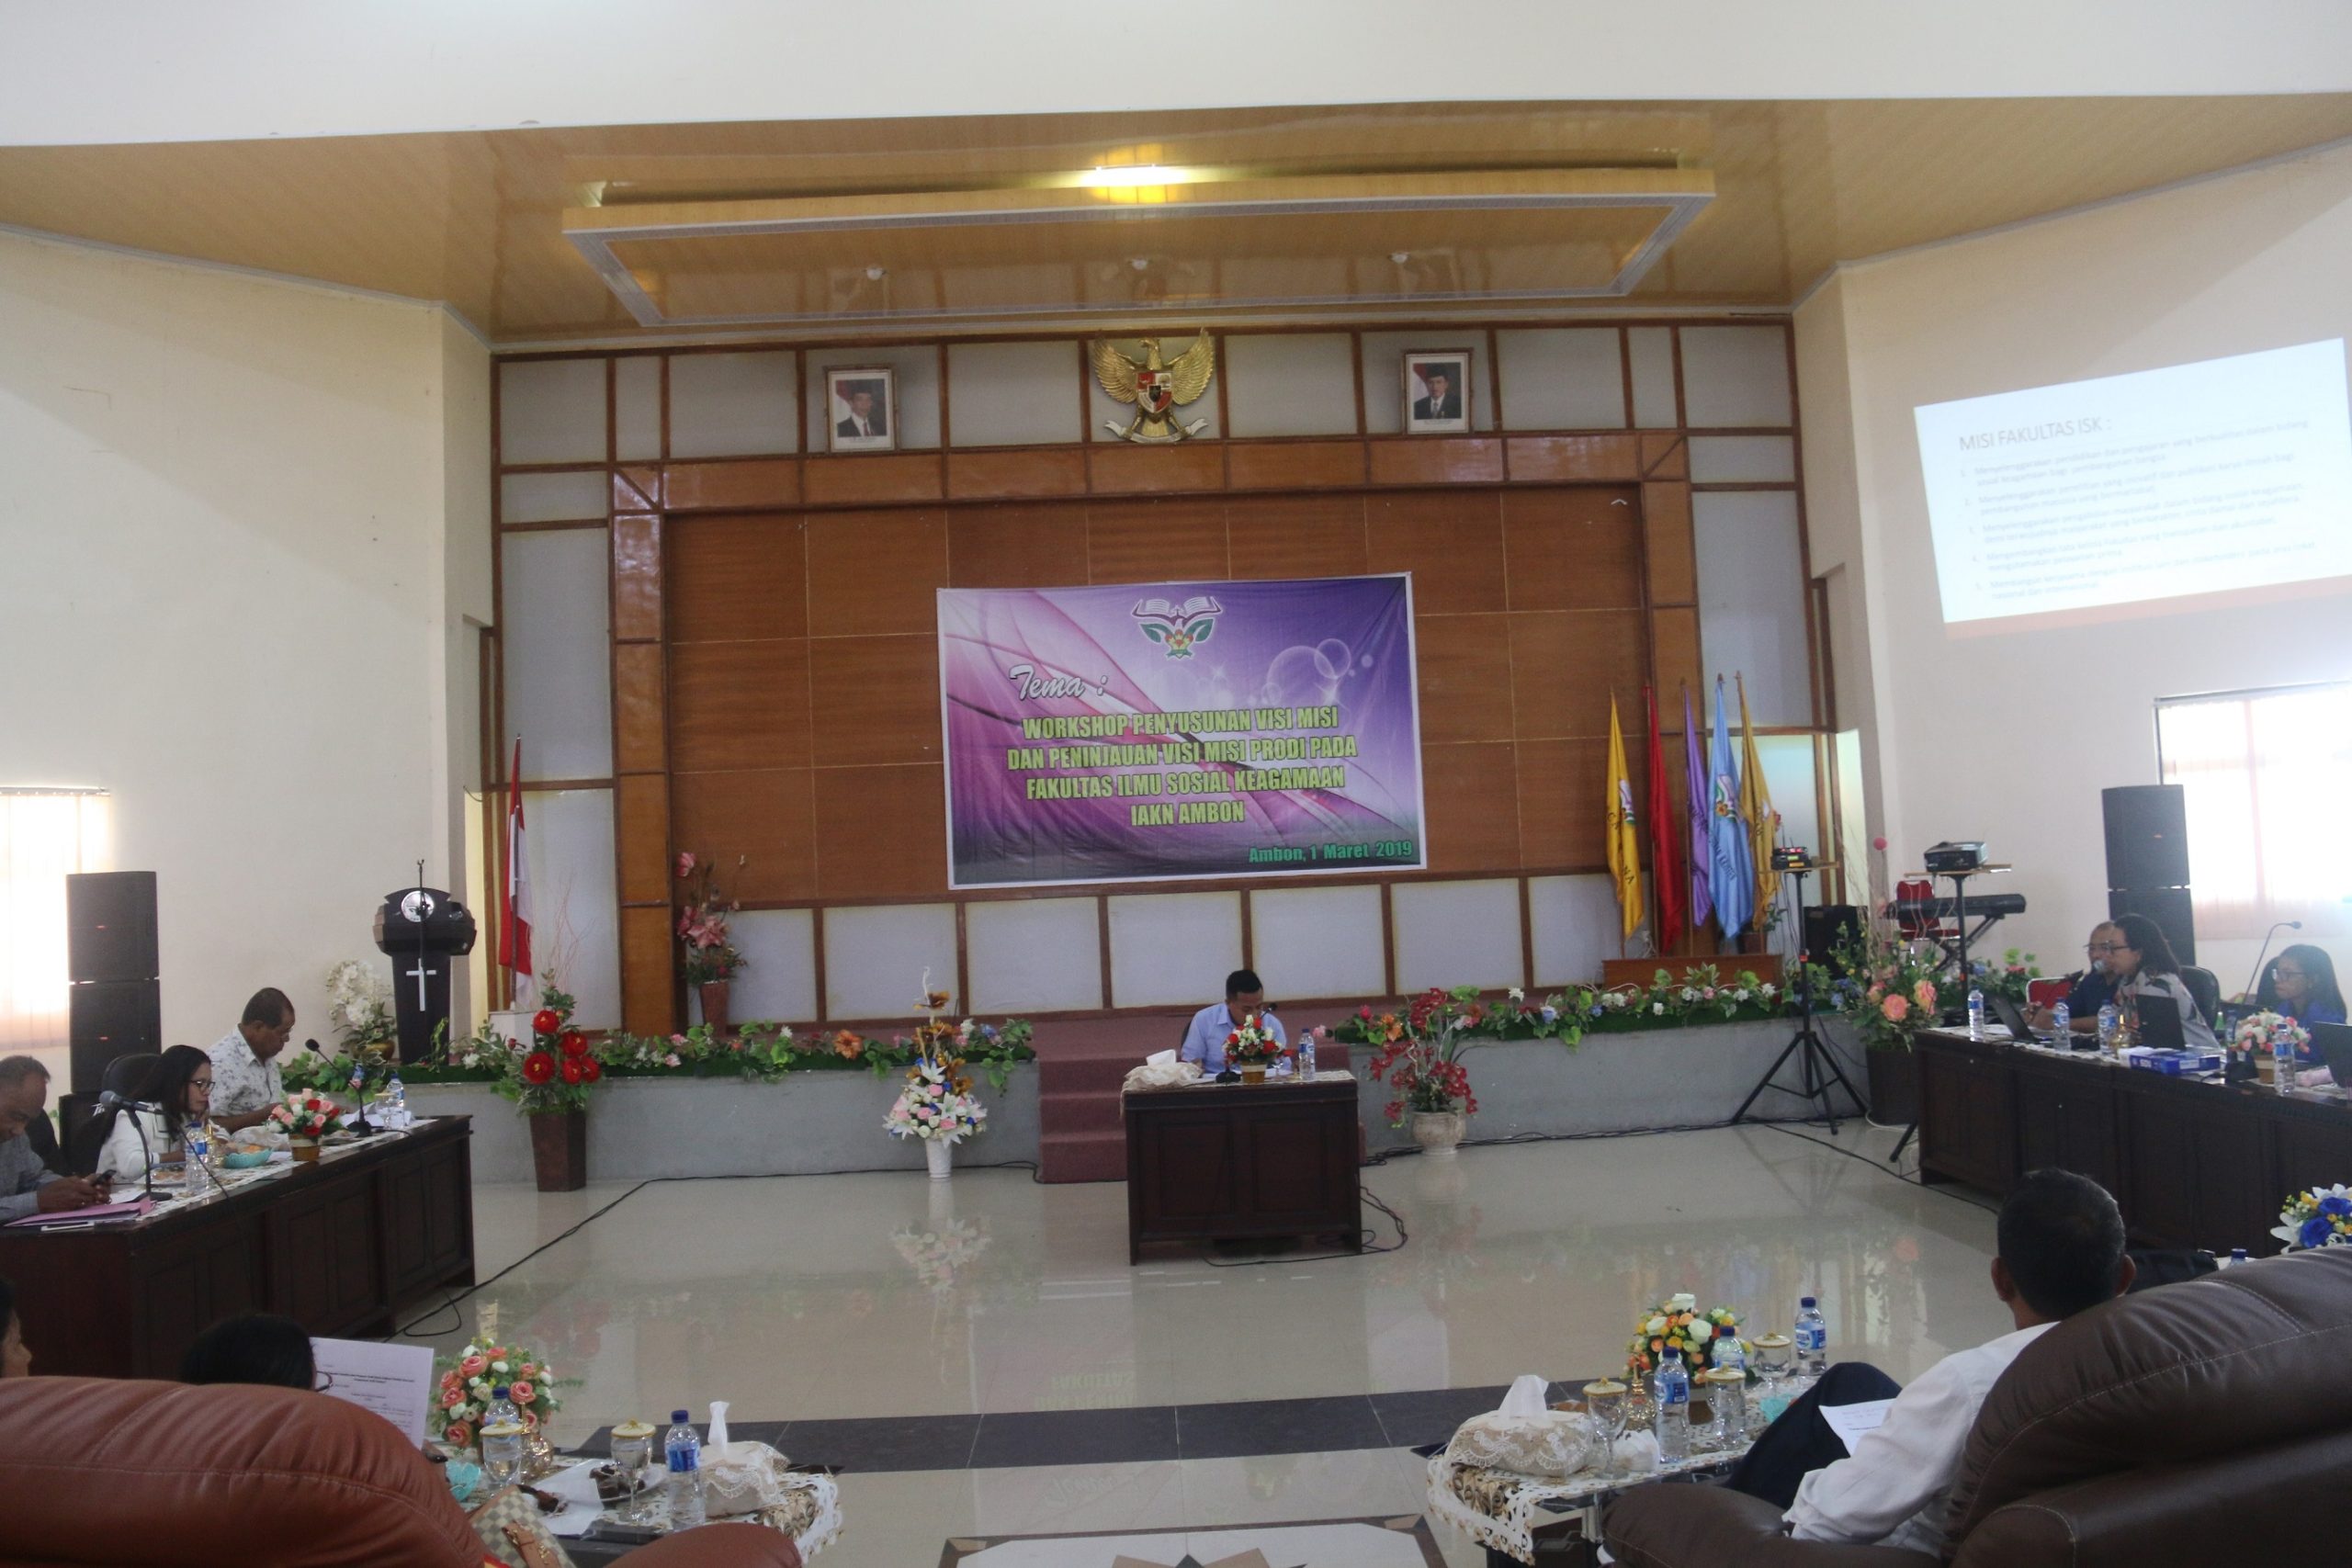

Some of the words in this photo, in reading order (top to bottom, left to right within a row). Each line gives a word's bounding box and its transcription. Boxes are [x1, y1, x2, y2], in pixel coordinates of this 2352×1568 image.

[1960, 432, 1995, 450] MISI
[1998, 421, 2074, 445] FAKULTAS
[2077, 417, 2102, 434] ISK
[1010, 665, 1085, 701] Tema
[1023, 714, 1129, 739] WORKSHOP
[1132, 709, 1251, 736] PENYUSUNAN
[1254, 706, 1294, 731] VISI
[1296, 705, 1339, 728] MISI
[1008, 748, 1045, 771] DAN
[1048, 742, 1159, 770] PENINJAUAN
[1162, 741, 1200, 765] VISI
[1204, 739, 1246, 762] MISI
[1250, 738, 1306, 761] PRODI
[1310, 735, 1359, 759] PADA
[1026, 775, 1114, 801] FAKULTAS
[1116, 773, 1162, 796] ILMU
[1167, 770, 1231, 795] SOSIAL
[1234, 764, 1346, 792] KEAGAMAAN
[1131, 803, 1174, 827] IAKN
[1178, 799, 1246, 825] AMBON
[1249, 846, 1306, 863] Ambon,
[1309, 844, 1317, 861] 1
[1322, 842, 1370, 860] Maret
[1375, 840, 1413, 858] 2019
